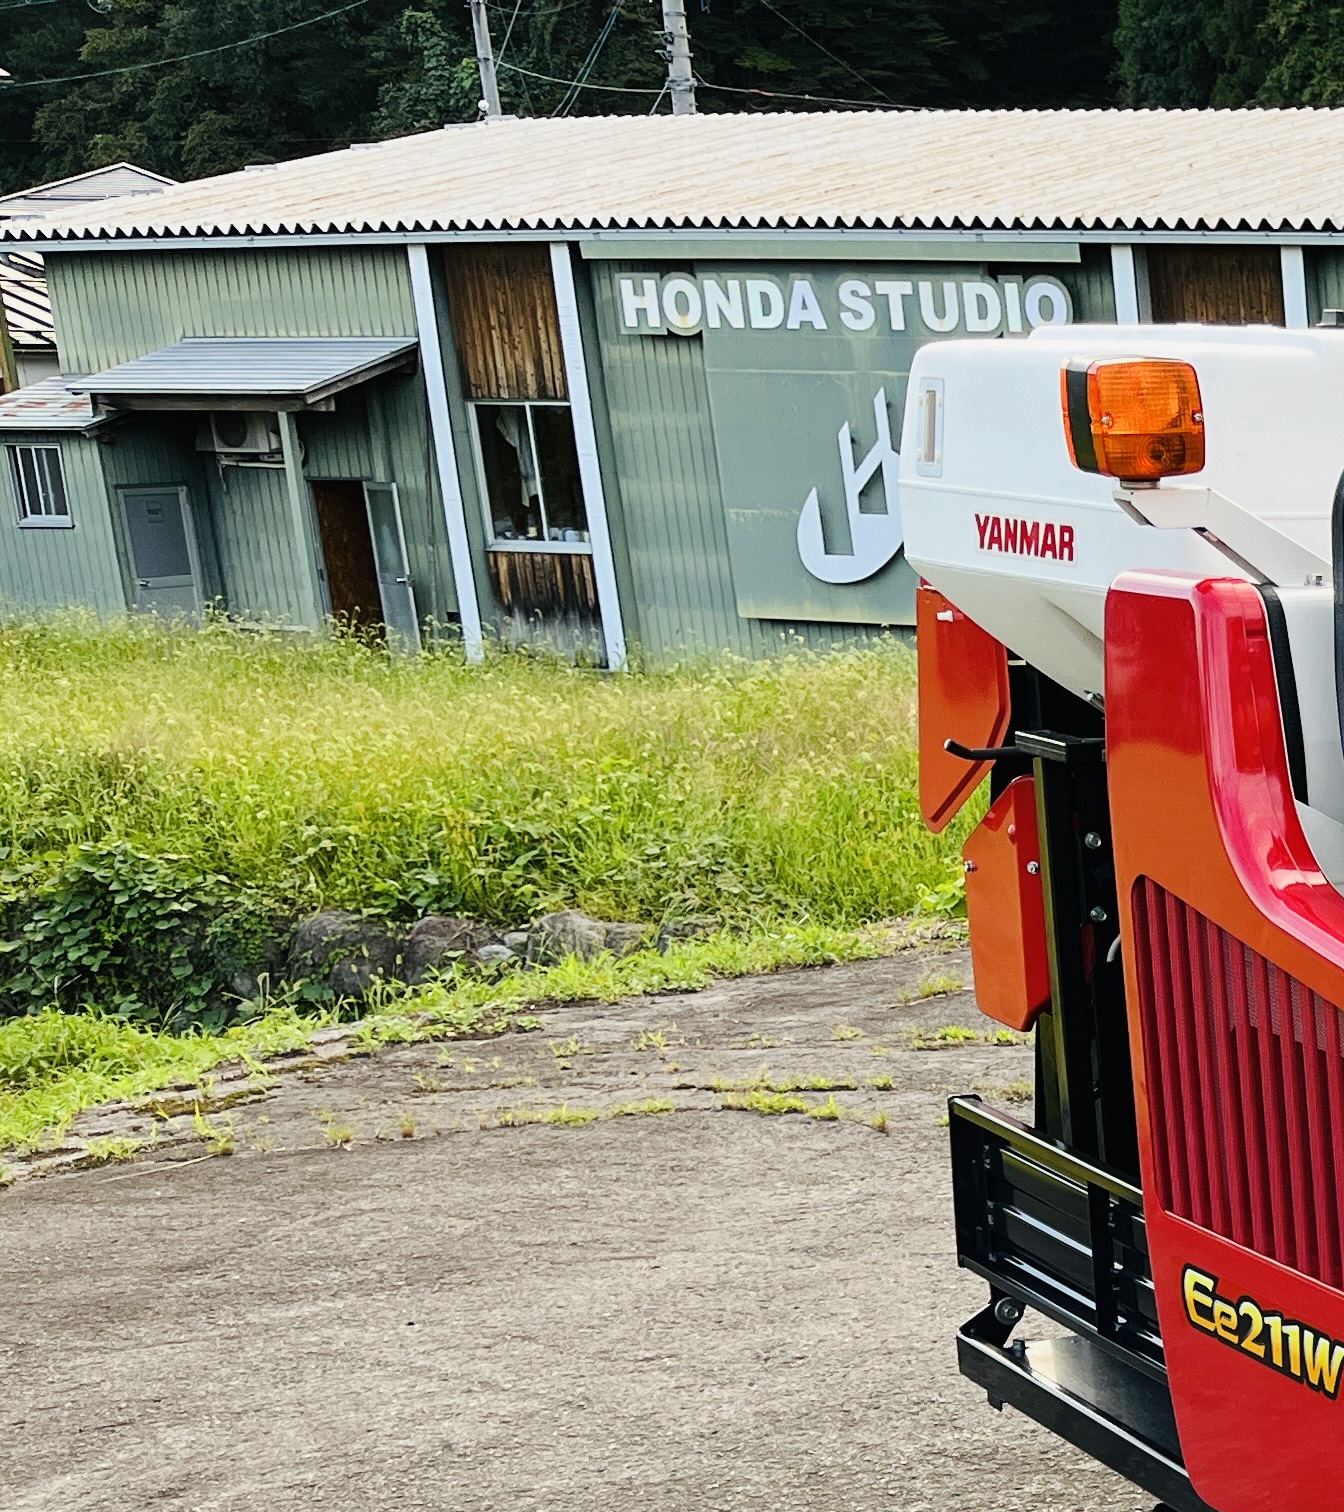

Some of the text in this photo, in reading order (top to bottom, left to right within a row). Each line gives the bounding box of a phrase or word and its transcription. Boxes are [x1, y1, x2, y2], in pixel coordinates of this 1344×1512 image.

[619, 277, 1069, 333] HONDA STUDIO
[975, 513, 1075, 562] YANMAR
